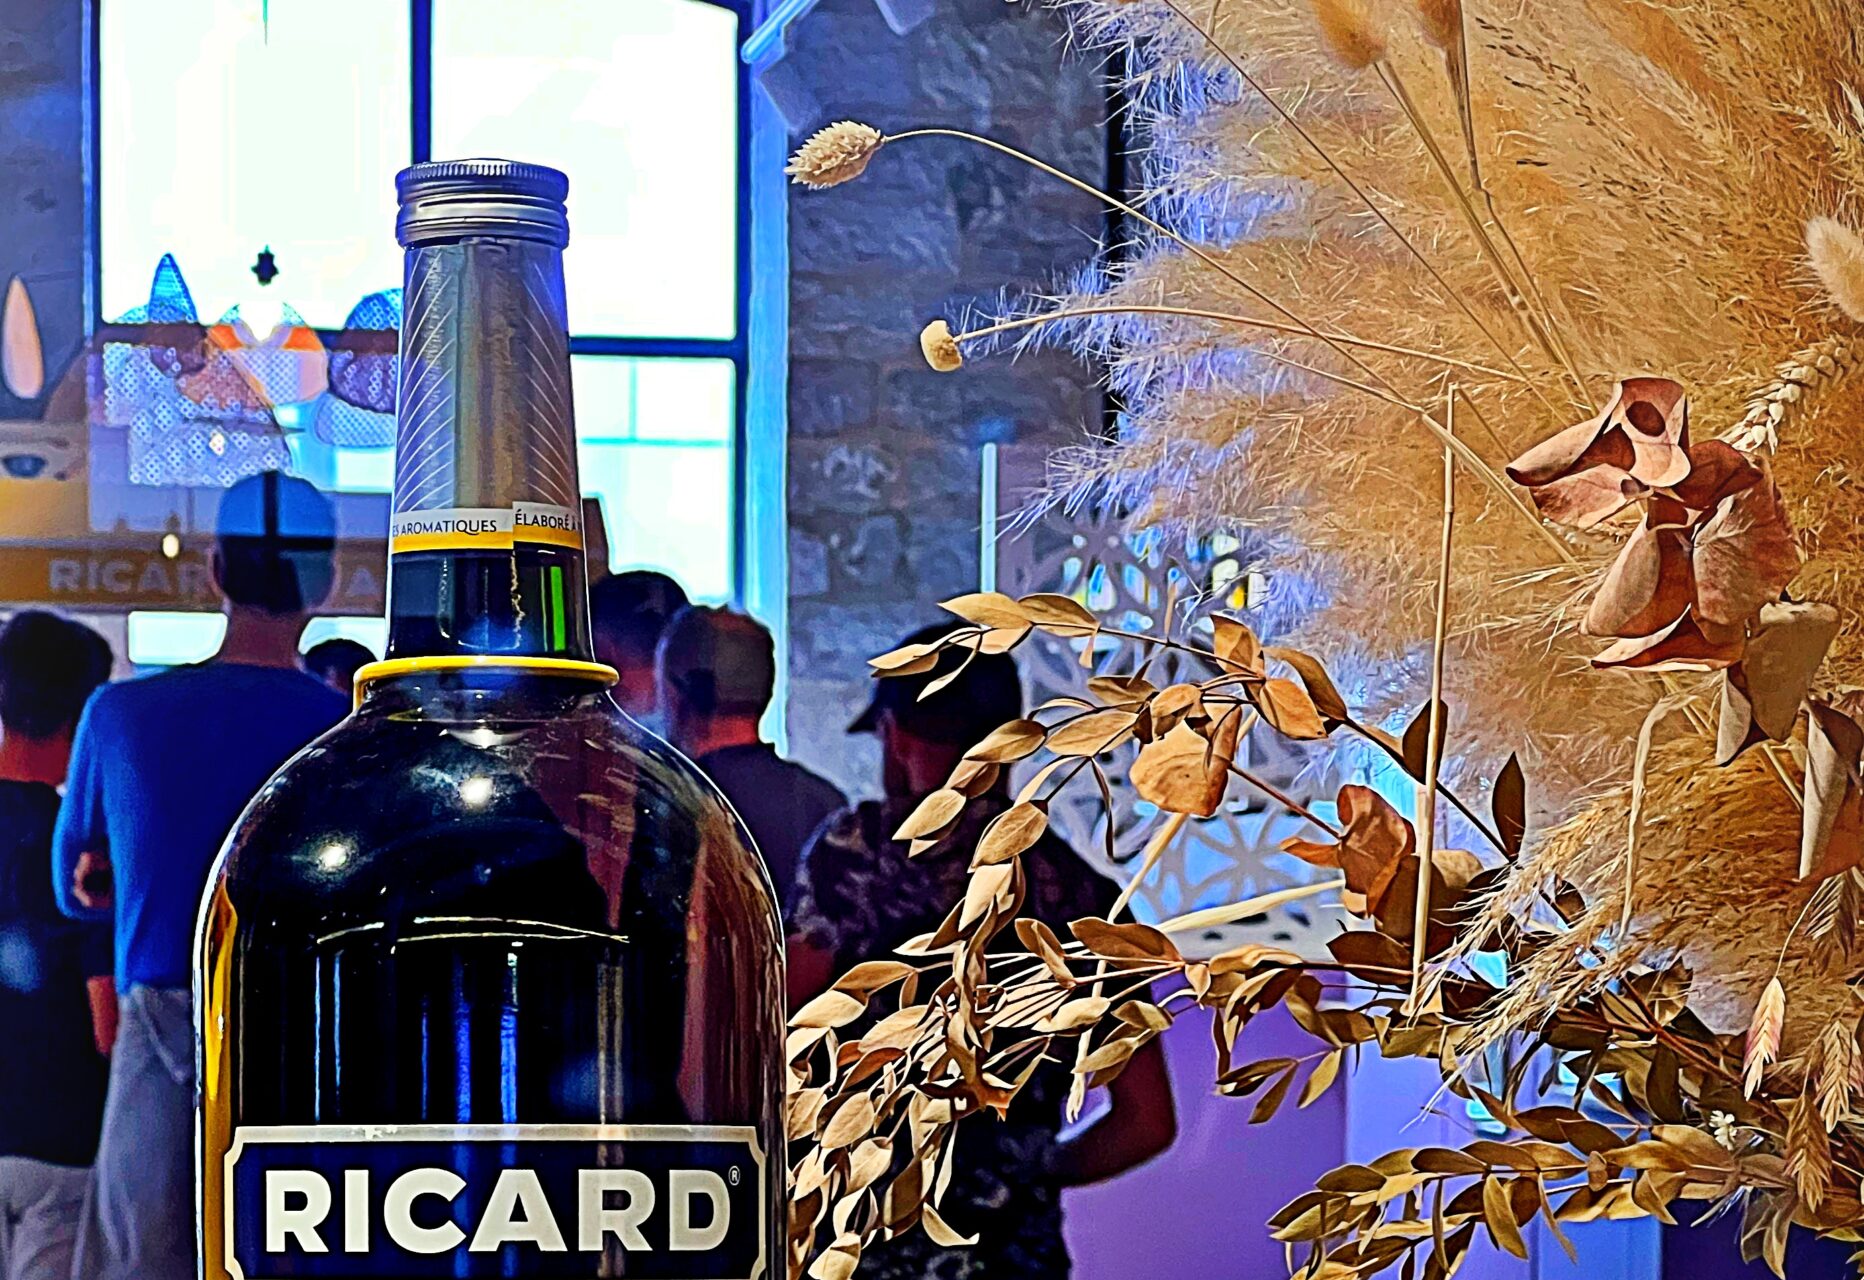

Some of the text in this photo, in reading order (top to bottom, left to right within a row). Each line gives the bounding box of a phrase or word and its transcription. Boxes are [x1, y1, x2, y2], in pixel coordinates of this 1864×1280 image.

[401, 519, 498, 536] AROMATIQUES
[514, 509, 570, 531] ÉLABORÉ
[50, 559, 205, 594] RICAR
